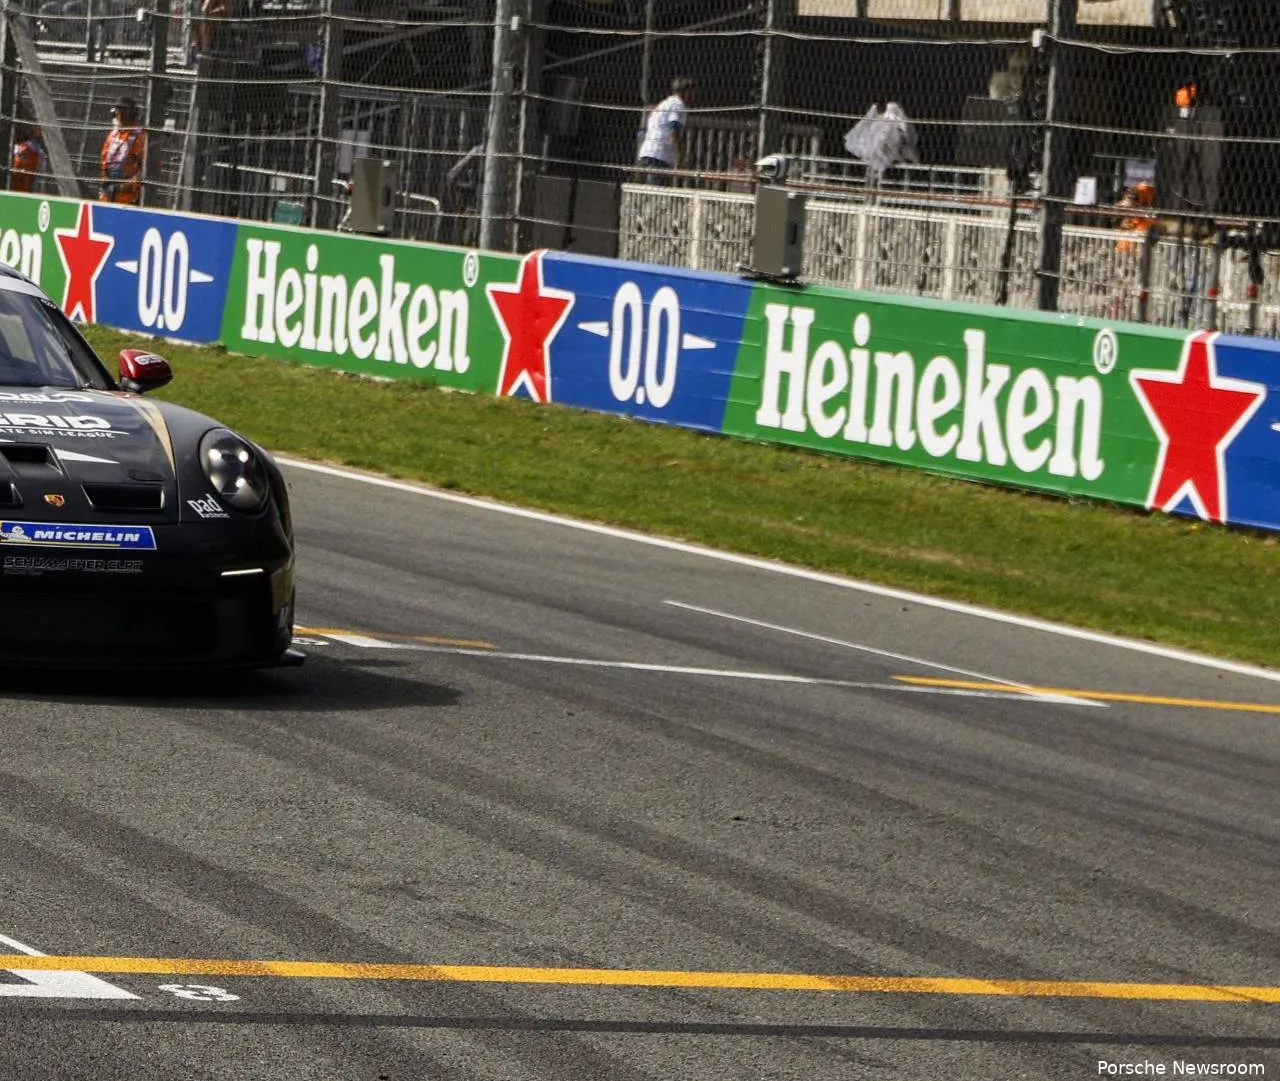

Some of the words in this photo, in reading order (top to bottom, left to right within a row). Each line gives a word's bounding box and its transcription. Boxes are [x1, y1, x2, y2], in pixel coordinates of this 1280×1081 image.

[241, 238, 471, 373] Heineken
[755, 303, 1105, 481] Heineken
[28, 429, 54, 437] SIM
[59, 431, 116, 439] LEAGUE
[187, 493, 223, 518] pad
[34, 530, 140, 542] MICHELIN
[3, 556, 105, 570] SCHUMACHER
